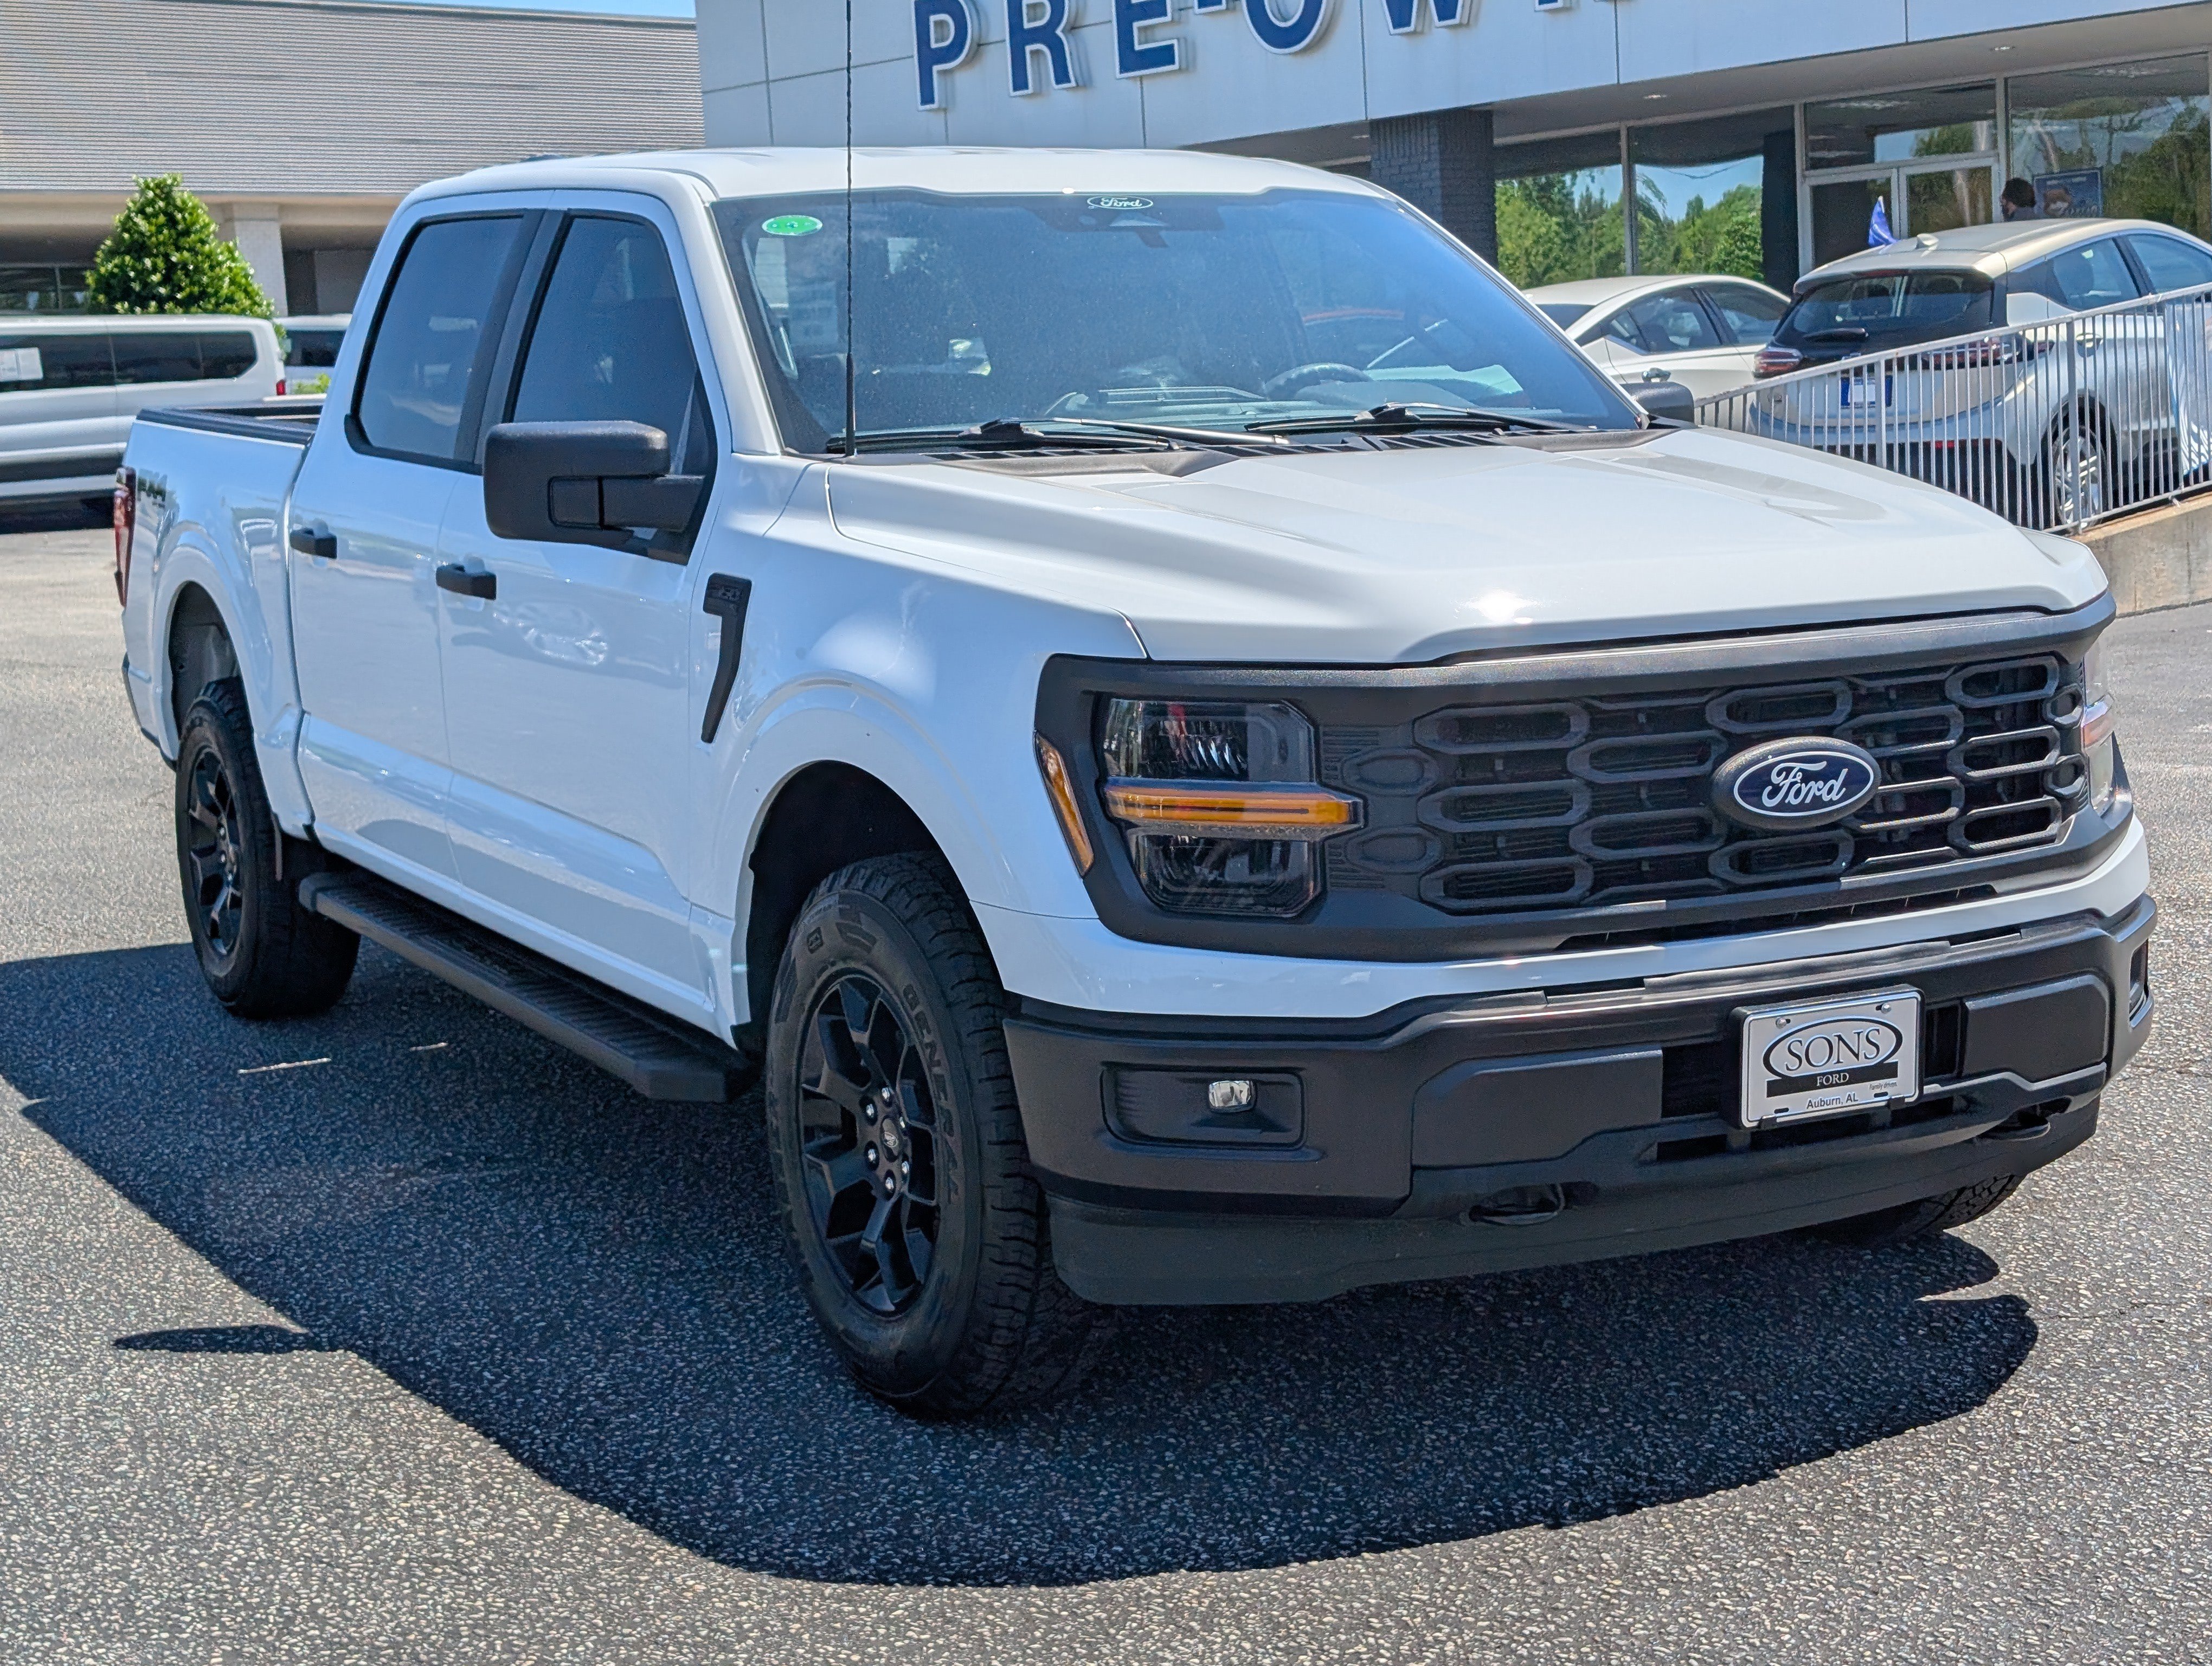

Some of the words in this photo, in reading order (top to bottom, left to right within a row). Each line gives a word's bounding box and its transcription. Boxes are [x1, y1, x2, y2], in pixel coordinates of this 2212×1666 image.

[1100, 197, 1142, 206] Ford
[1761, 760, 1849, 808] Ford
[1785, 1028, 1881, 1072] SONS
[1816, 1072, 1849, 1086] FORD
[1806, 1095, 1843, 1110] Auburn,
[1846, 1092, 1859, 1103] AL
